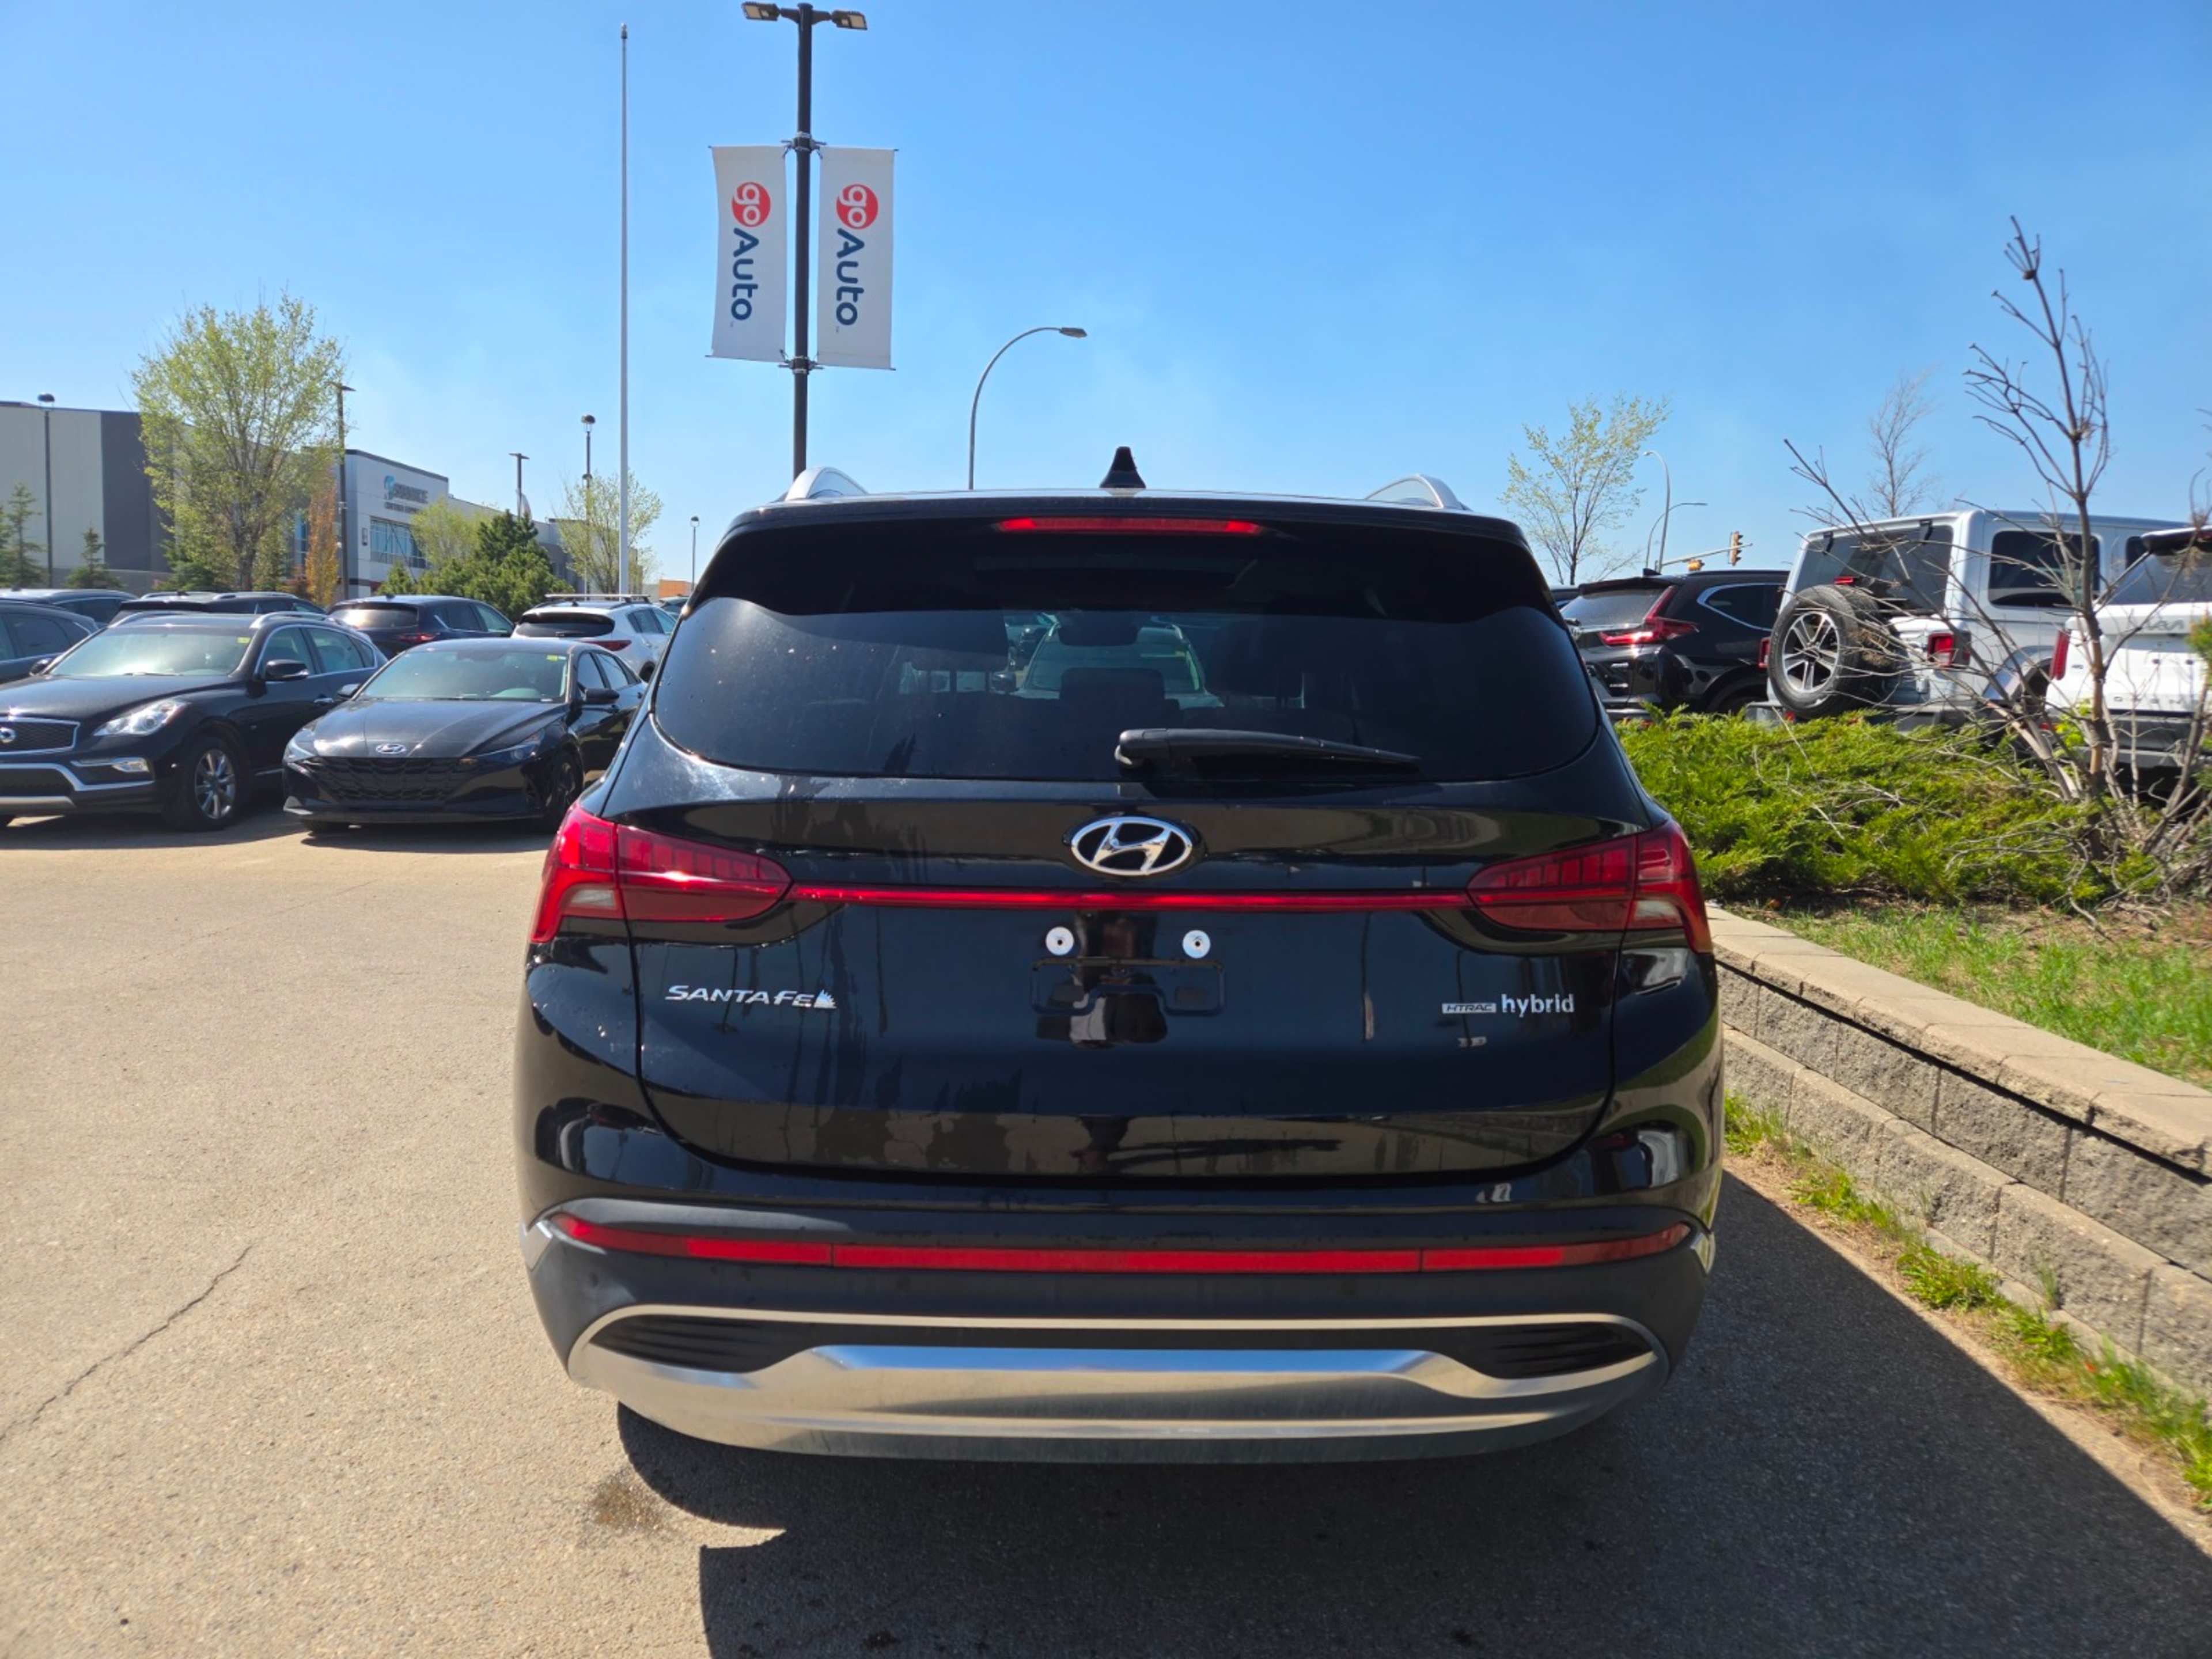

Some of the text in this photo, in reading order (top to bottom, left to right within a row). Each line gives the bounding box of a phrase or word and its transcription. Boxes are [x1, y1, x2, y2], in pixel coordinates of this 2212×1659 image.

[731, 184, 761, 321] go Auto
[836, 185, 867, 326] go Auto
[1444, 994, 1574, 1017] HTRAC hybrid
